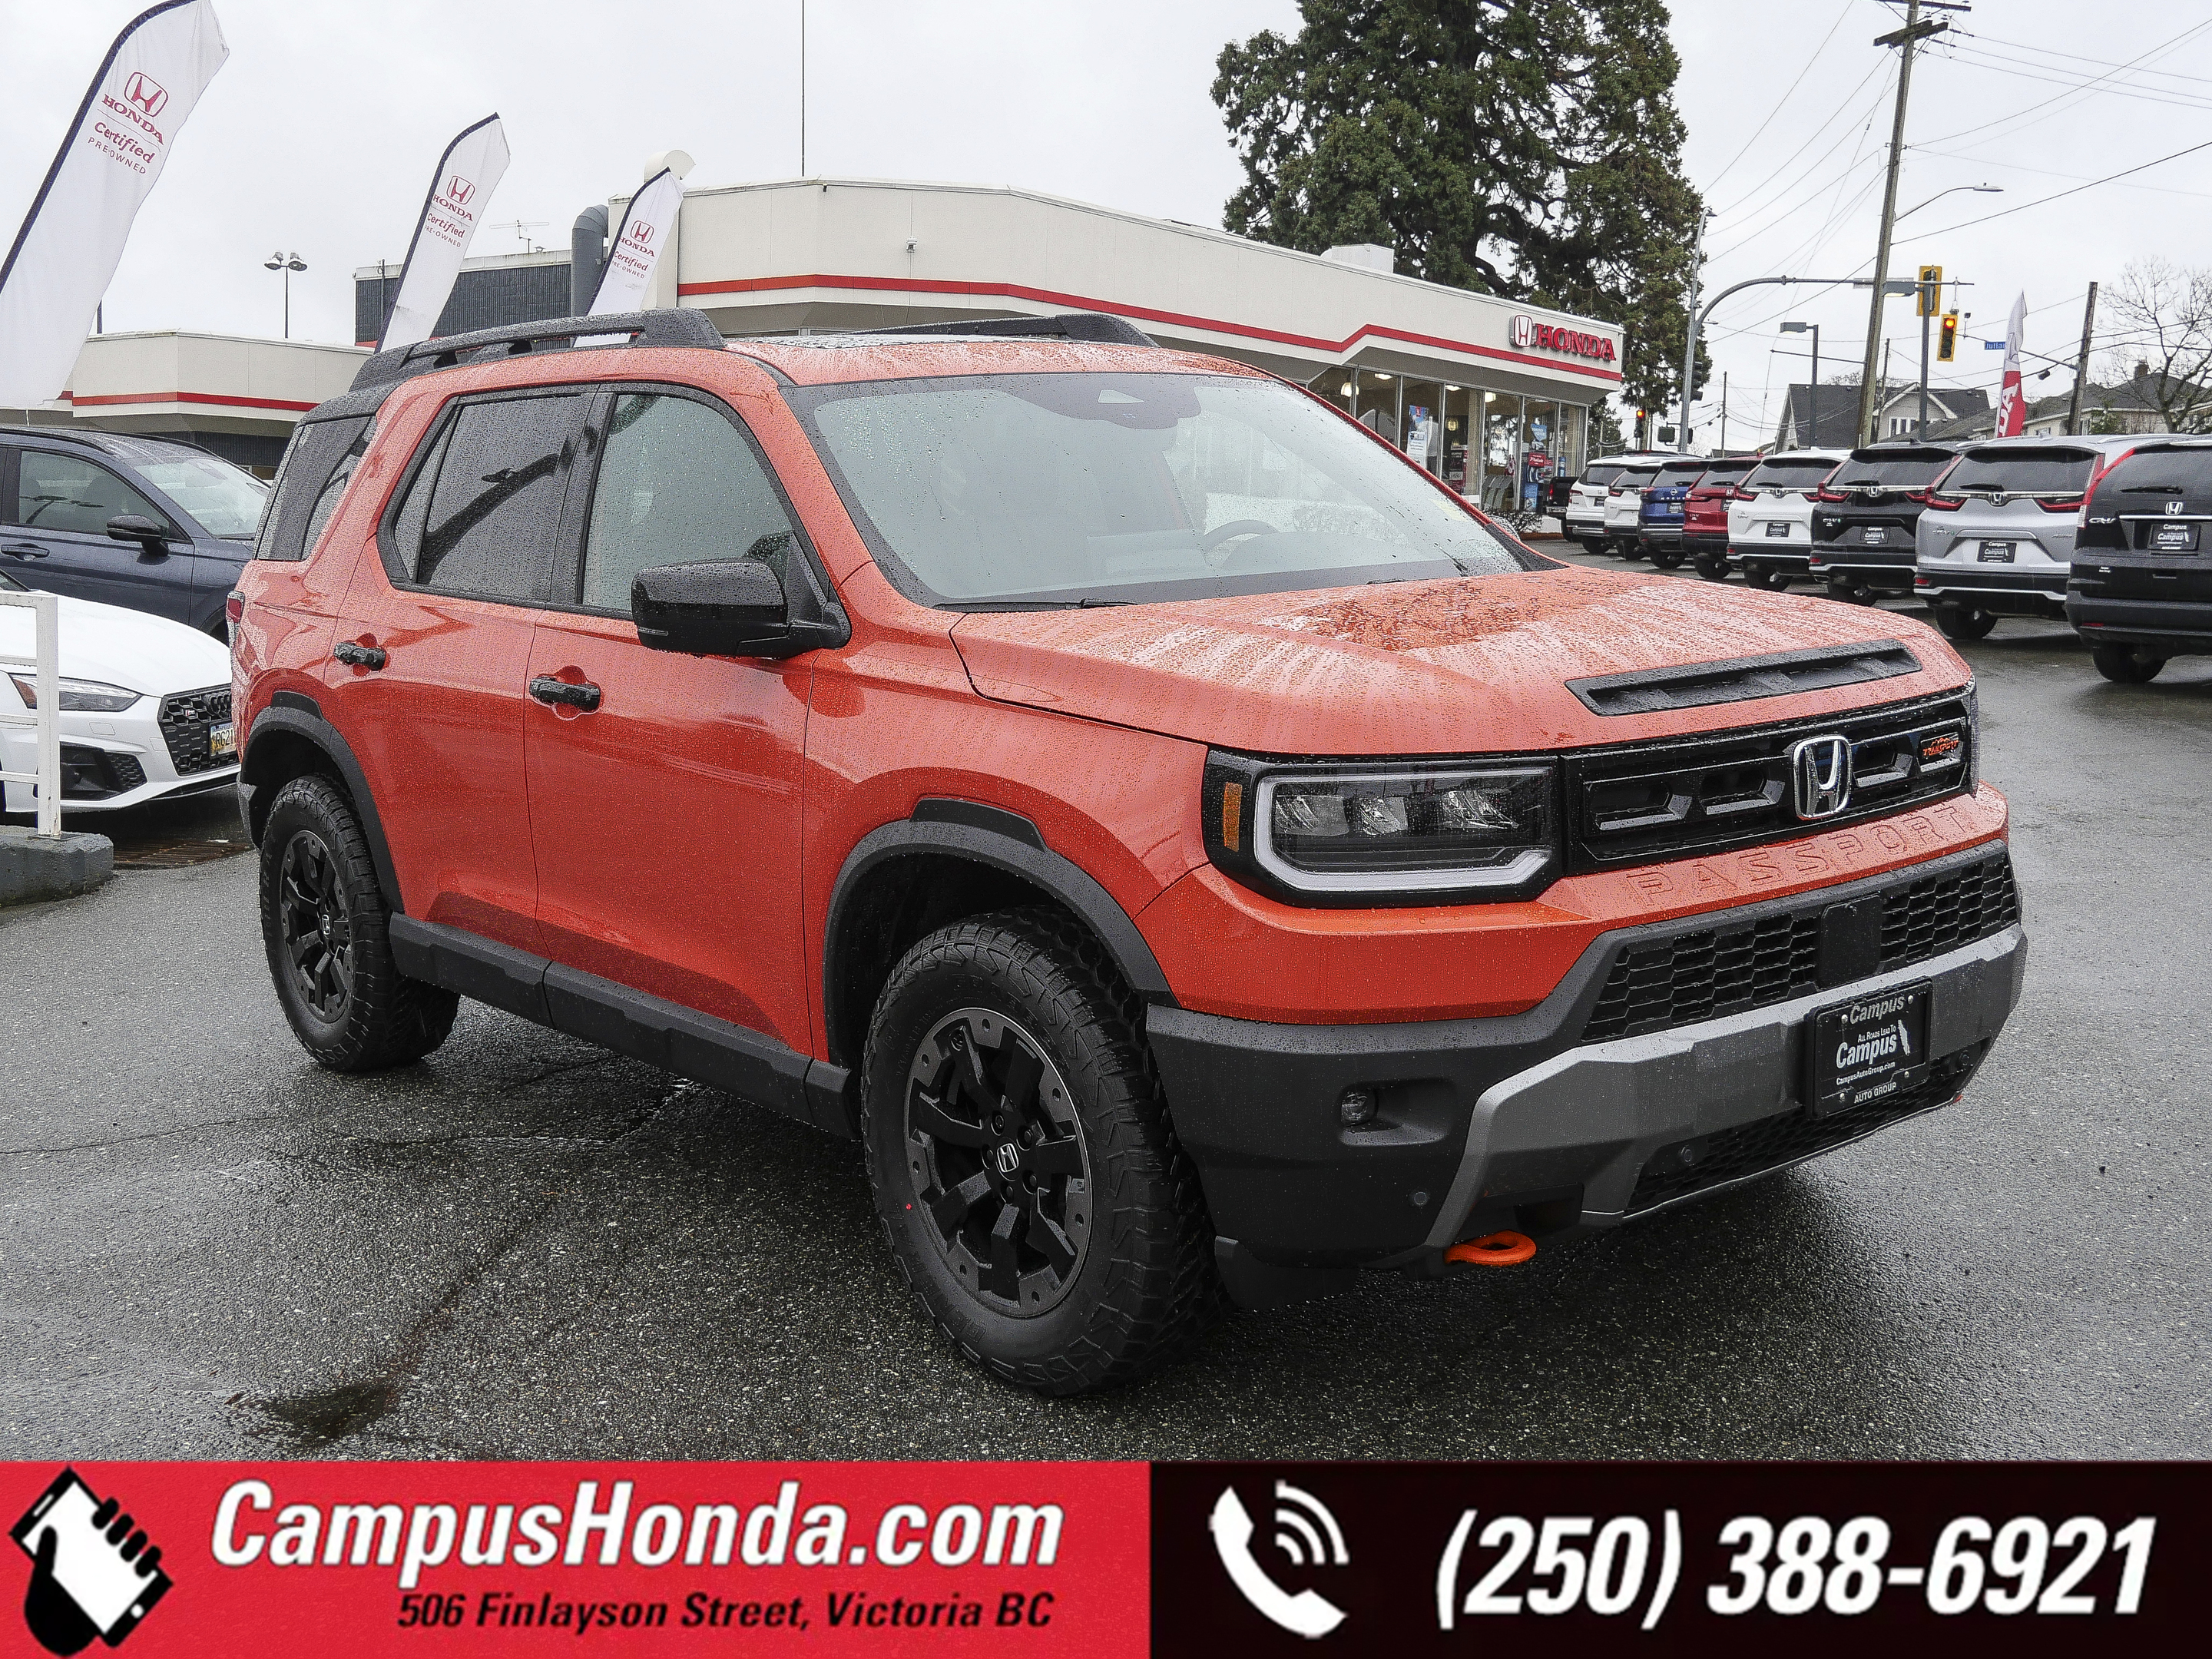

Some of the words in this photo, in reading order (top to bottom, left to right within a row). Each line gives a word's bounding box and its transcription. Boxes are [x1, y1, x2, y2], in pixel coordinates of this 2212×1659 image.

[101, 94, 164, 145] HONDA
[94, 122, 155, 164] Certified
[433, 194, 473, 222] HONDA
[425, 225, 461, 247] RE-OWNED
[427, 213, 465, 238] Certified
[614, 250, 649, 271] Certified
[1535, 323, 1617, 361] HONDA
[2157, 532, 2184, 541] Campus
[1626, 806, 1966, 906] PASSPORT
[1849, 996, 1906, 1024] Campus
[1836, 1034, 1897, 1068] Campus
[1836, 1061, 1896, 1085] CampusAutoGroup.com
[1853, 1090, 1873, 1104] AUTO
[1873, 1081, 1897, 1097] GROUP
